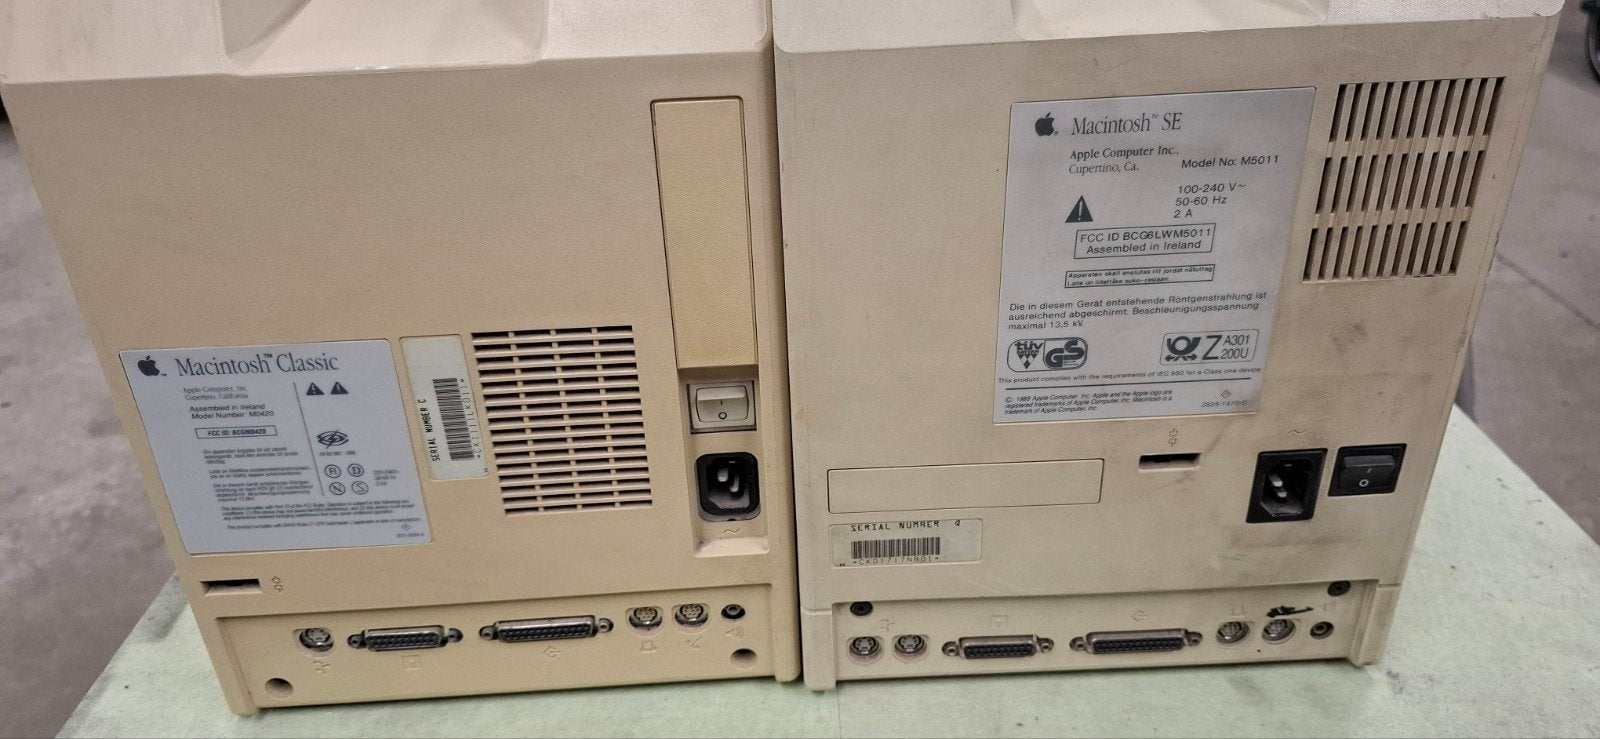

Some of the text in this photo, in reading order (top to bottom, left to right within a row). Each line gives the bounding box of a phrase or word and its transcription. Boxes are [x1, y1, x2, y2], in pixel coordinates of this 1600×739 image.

[1161, 112, 1183, 131] SE
[1070, 149, 1099, 161] Apple
[1101, 147, 1153, 159] Computer
[1068, 161, 1139, 176] Cupertino, Ca.
[1181, 154, 1279, 169] Model No: M5011
[1178, 183, 1225, 194] 100-240
[1175, 195, 1228, 206] 50-60 Hz
[1173, 209, 1193, 219] 2 A
[1080, 228, 1211, 243] FCC ID BCG6LWM5011
[1087, 240, 1202, 254] Assembled in Ireland
[1009, 303, 1025, 311] Die
[1028, 302, 1037, 310] in
[1039, 301, 1073, 310] diesem
[1105, 296, 1165, 307] entstehende
[1255, 291, 1268, 299] ist
[1008, 310, 1066, 321] ausreichend
[1132, 302, 1259, 315] Beschleunigungsspannung
[1008, 321, 1046, 330] maximal
[1223, 334, 1250, 346] A301
[1201, 335, 1222, 360] Z
[276, 352, 340, 373] Classic
[1013, 376, 1039, 384] product
[1041, 375, 1071, 383] complies
[1101, 371, 1146, 380] requirements
[190, 404, 230, 412] Assembled
[191, 412, 213, 420] Model
[420, 407, 434, 433] NUMBER
[207, 429, 220, 437] FCC
[427, 438, 440, 462] SERIAL
[850, 522, 891, 532] SERIAL
